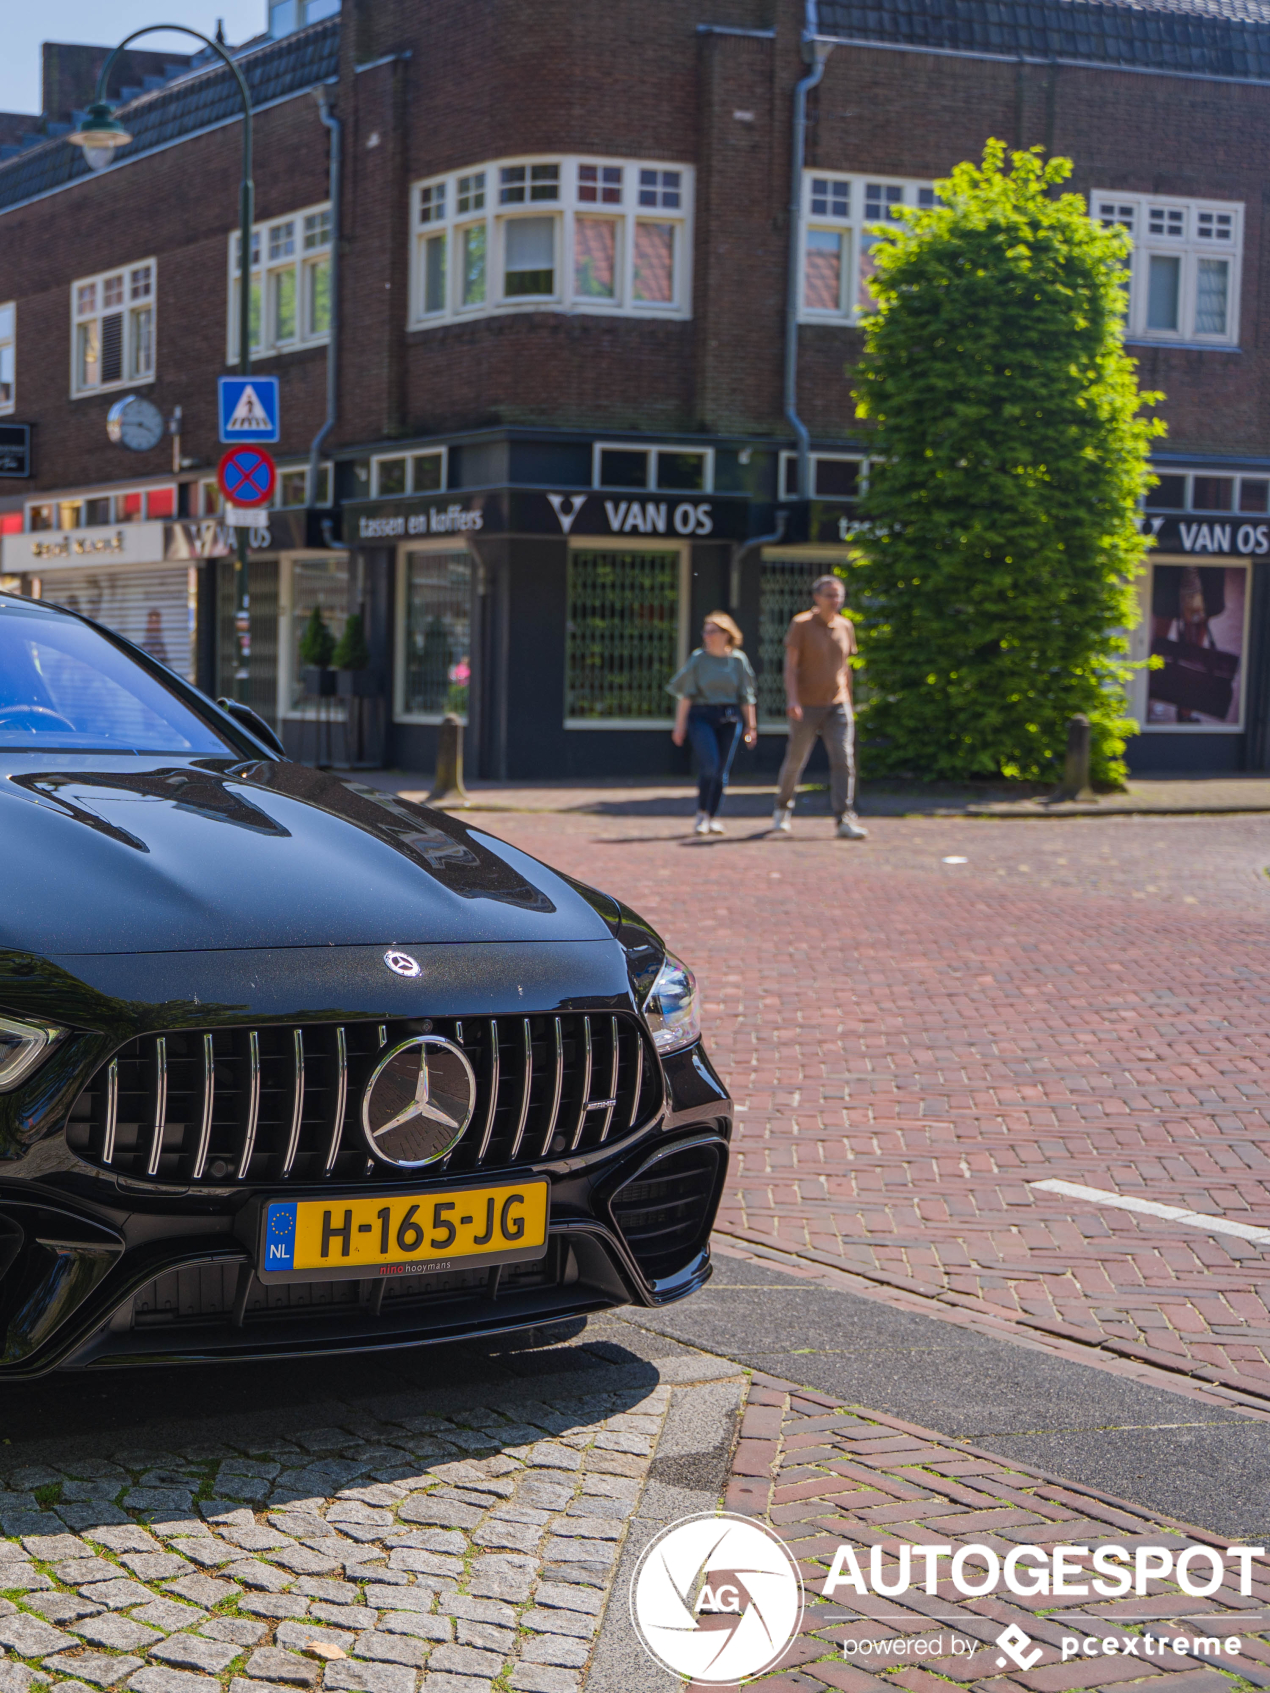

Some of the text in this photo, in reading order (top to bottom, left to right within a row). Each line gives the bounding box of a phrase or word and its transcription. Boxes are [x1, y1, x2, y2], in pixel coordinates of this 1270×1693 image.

[358, 503, 484, 538] tassen en koffers
[603, 500, 669, 534] VAN
[673, 502, 714, 536] OS
[1178, 522, 1232, 552] VAN
[1236, 524, 1270, 555] OS
[270, 1194, 525, 1259] NL H-165-JG
[379, 1260, 451, 1275] nino hooymans
